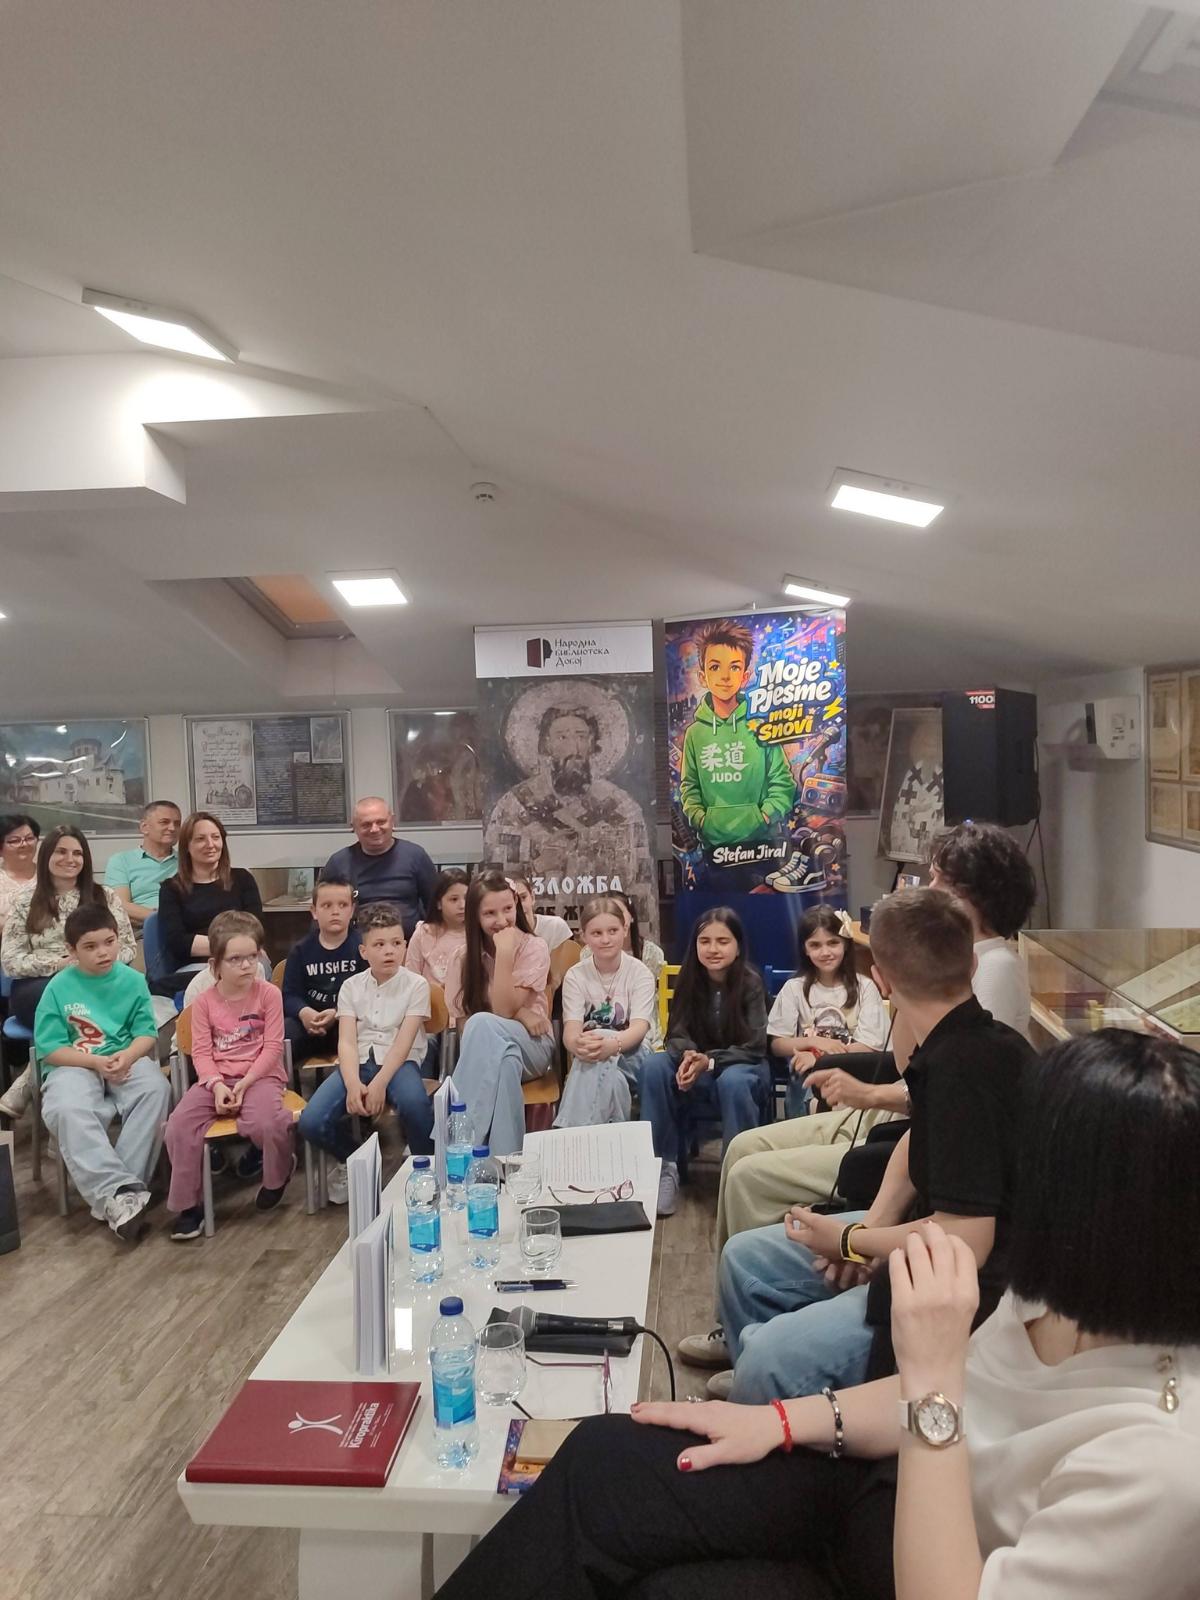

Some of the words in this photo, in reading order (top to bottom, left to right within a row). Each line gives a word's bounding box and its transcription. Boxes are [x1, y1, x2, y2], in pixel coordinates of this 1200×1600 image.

[758, 657, 822, 687] Moje
[748, 680, 832, 715] Pjesme
[768, 703, 804, 722] moji
[700, 741, 750, 772] 柔道
[710, 772, 742, 783] JUDO
[712, 845, 755, 864] Stefan
[756, 841, 787, 859] Jiral
[526, 875, 623, 895] ЗЛОЖБА
[306, 959, 356, 976] WISHES
